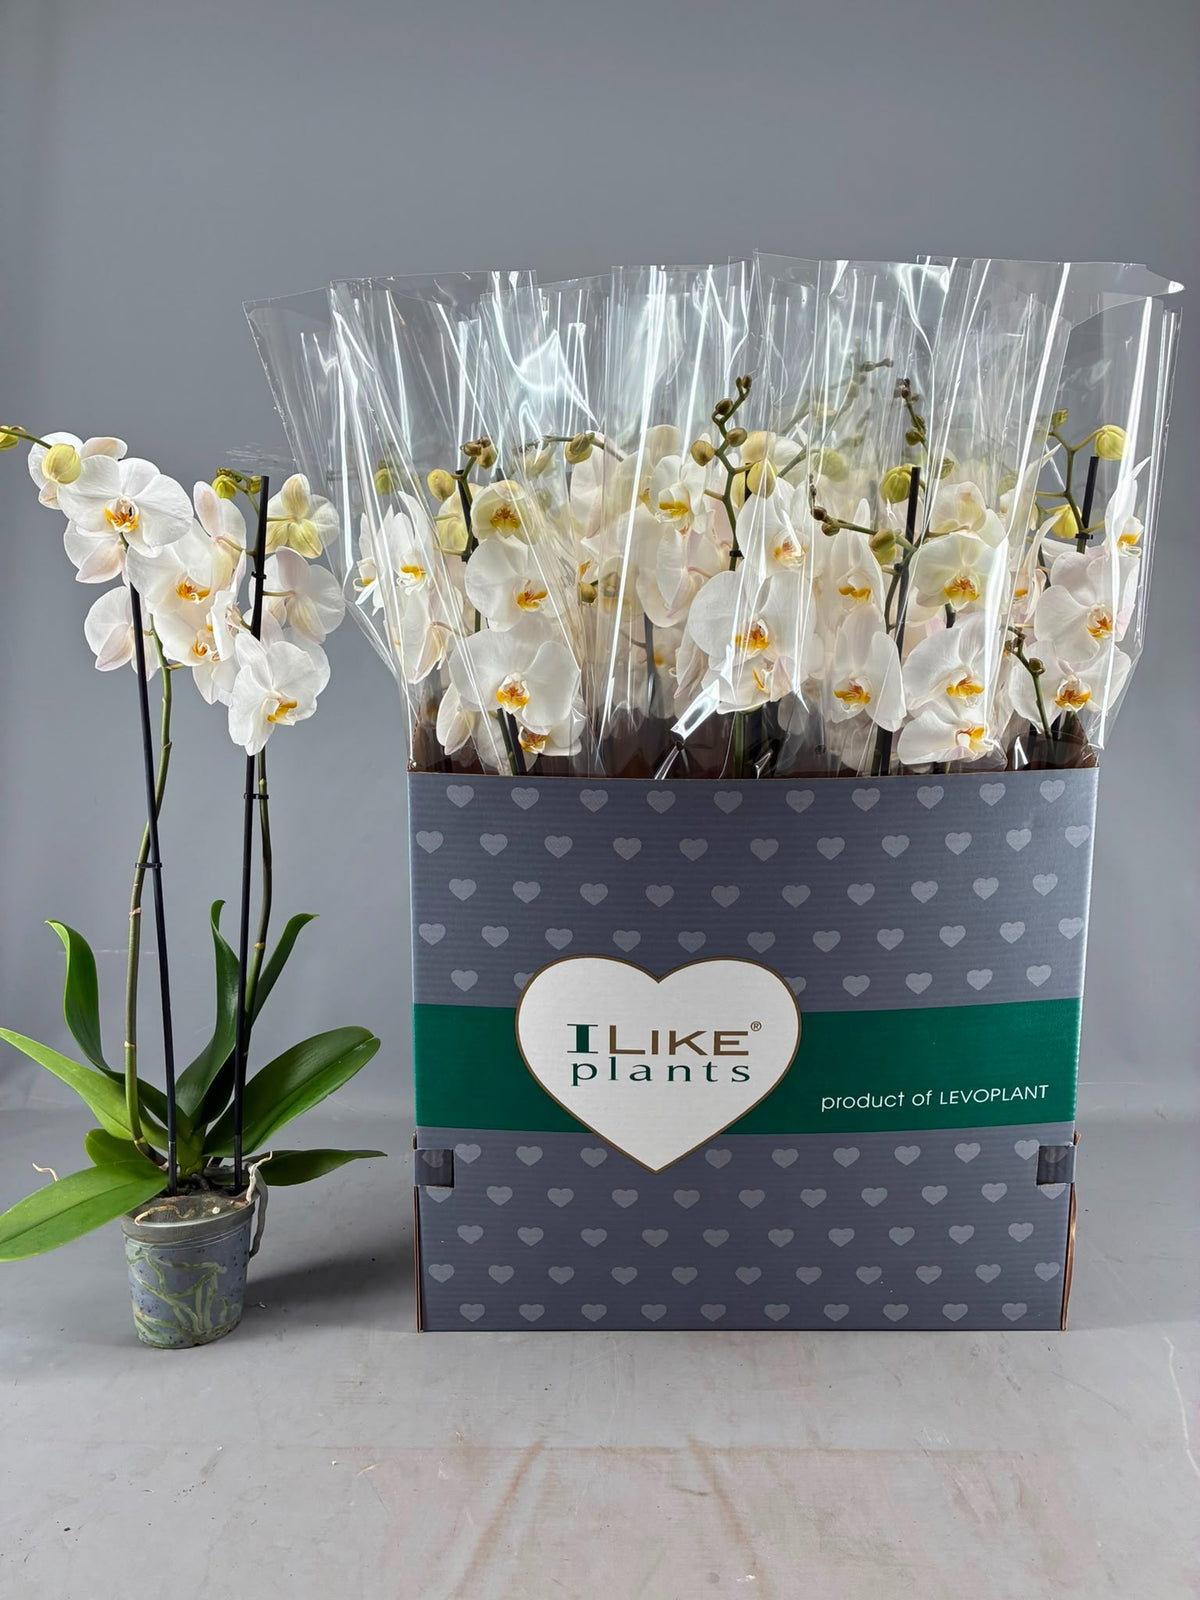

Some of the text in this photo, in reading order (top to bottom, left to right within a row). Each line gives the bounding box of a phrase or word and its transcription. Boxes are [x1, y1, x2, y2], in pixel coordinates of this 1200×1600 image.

[567, 1024, 599, 1054] I
[571, 1056, 751, 1086] plants
[821, 1084, 1050, 1112] product of LEVOPLANT
